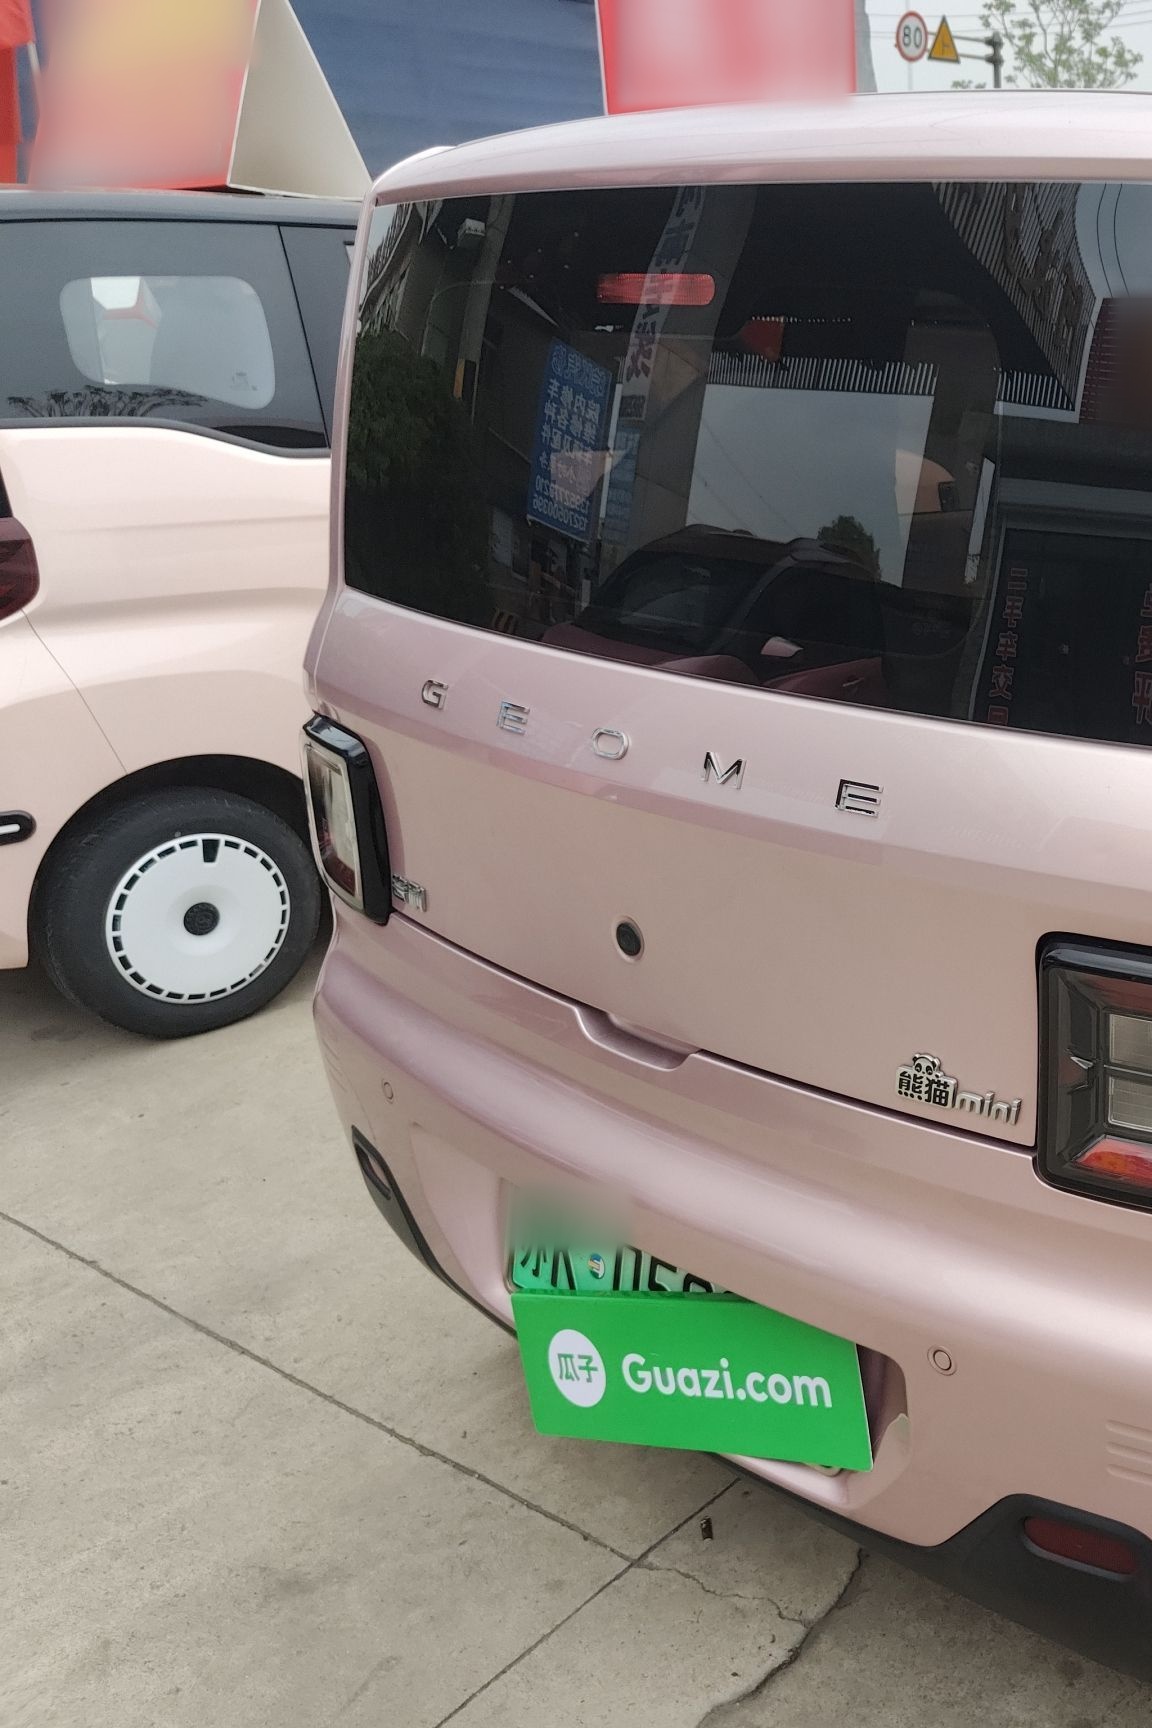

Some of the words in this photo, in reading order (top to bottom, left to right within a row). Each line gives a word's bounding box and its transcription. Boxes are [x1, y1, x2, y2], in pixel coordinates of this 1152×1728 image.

[902, 25, 922, 49] 80
[420, 679, 884, 818] GEOME
[897, 1070, 951, 1108] 熊猫
[954, 1091, 1022, 1126] mini
[556, 1352, 599, 1385] 瓜子
[621, 1352, 833, 1408] Guazi.com
